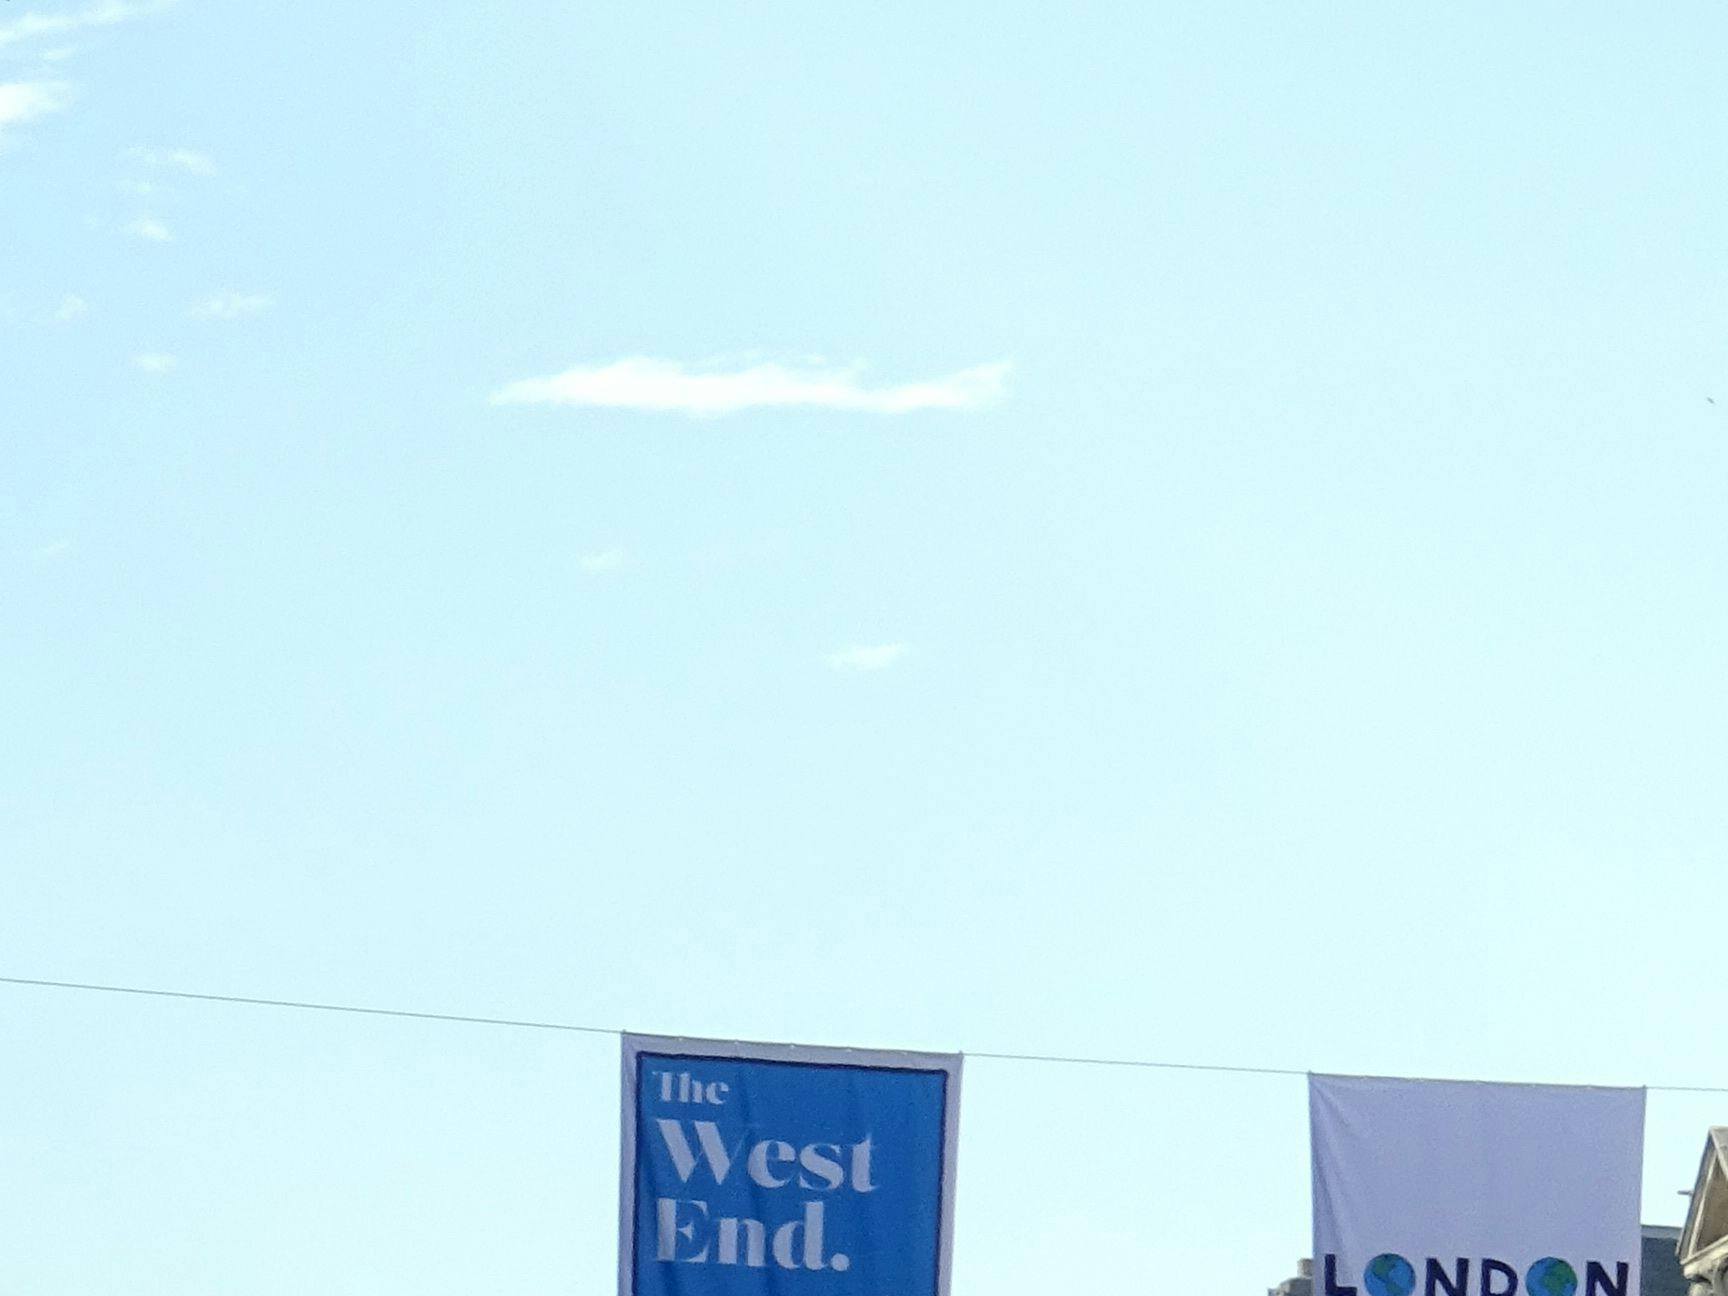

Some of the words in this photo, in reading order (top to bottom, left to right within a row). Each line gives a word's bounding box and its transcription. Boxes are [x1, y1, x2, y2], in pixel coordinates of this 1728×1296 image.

[653, 1071, 729, 1106] The
[657, 1119, 881, 1193] West
[656, 1197, 851, 1272] End.
